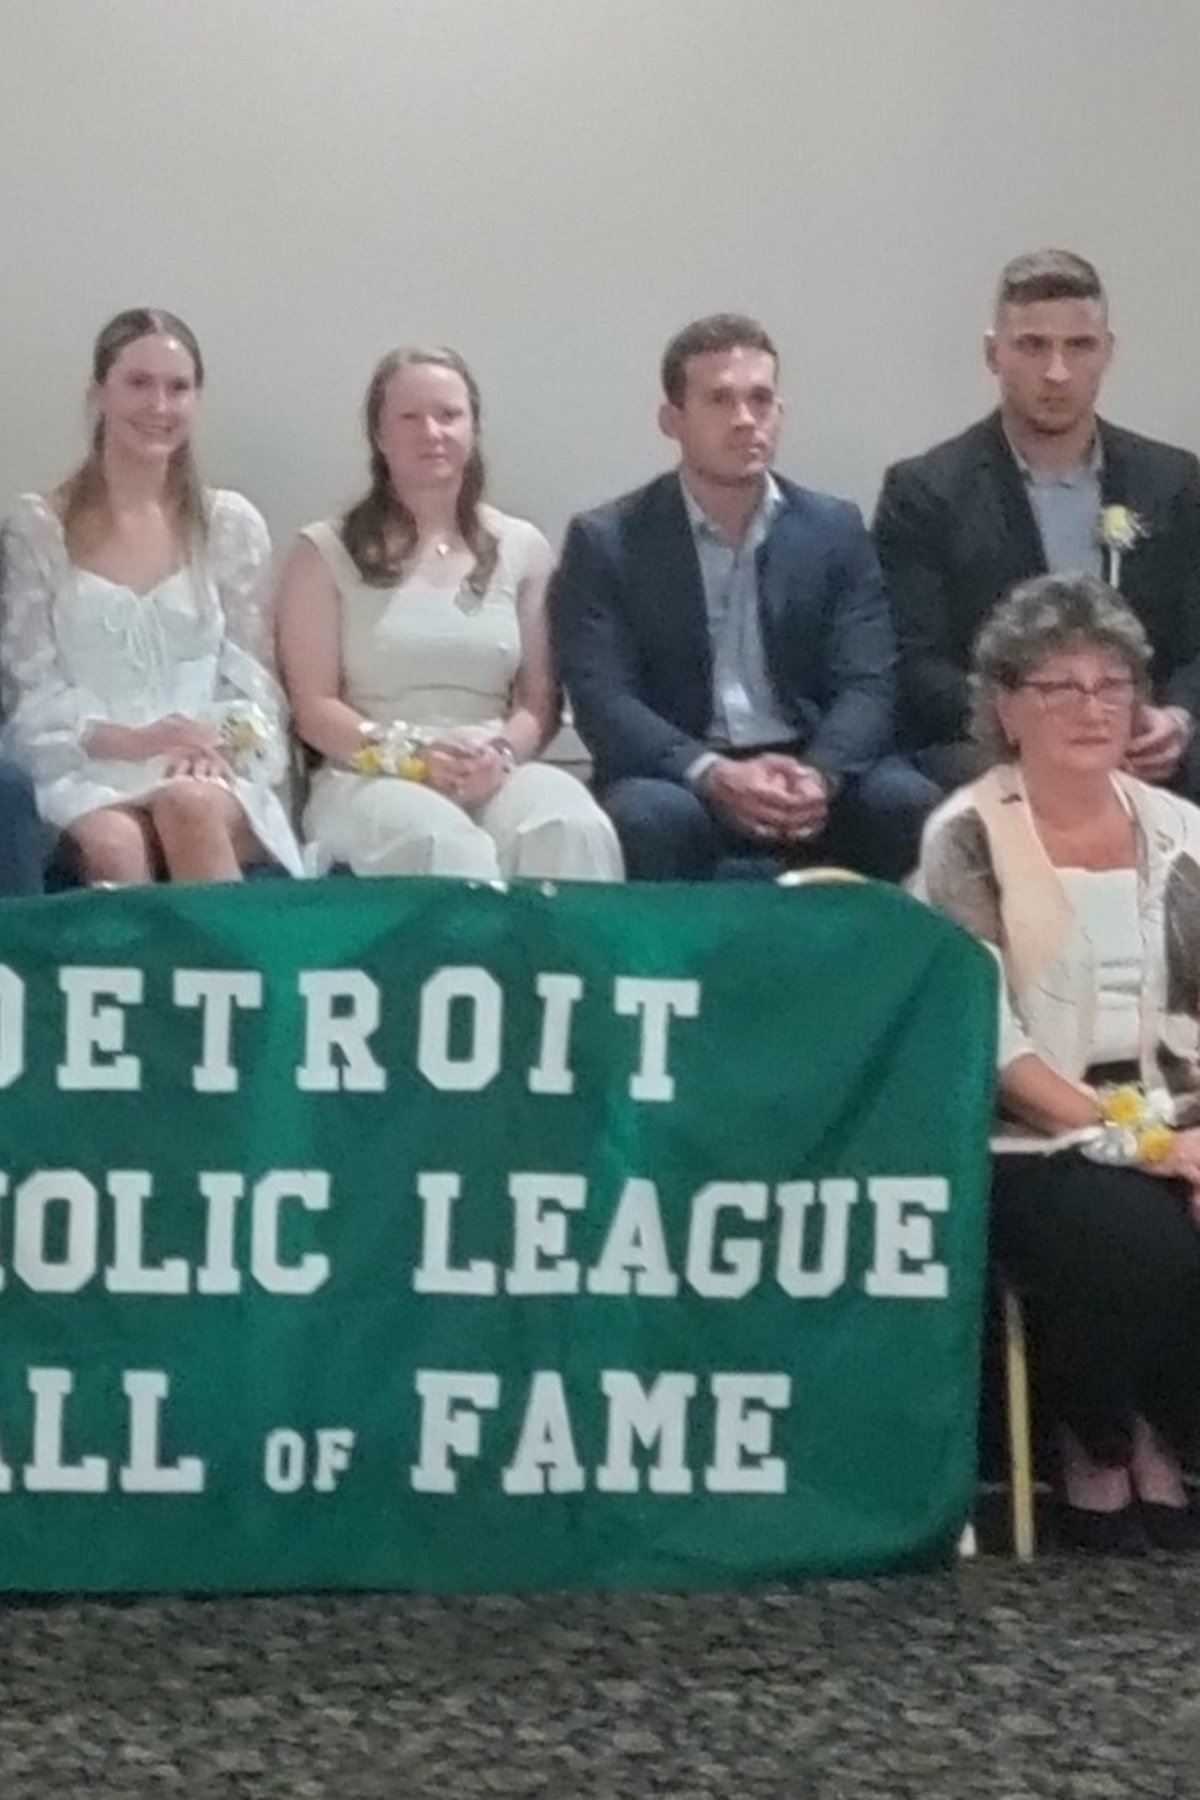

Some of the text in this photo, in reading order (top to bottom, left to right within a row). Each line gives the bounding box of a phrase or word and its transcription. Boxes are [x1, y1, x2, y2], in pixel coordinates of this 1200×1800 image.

[413, 1172, 950, 1299] LEAGUE
[264, 1428, 355, 1492] OF
[411, 1370, 791, 1494] FAME
